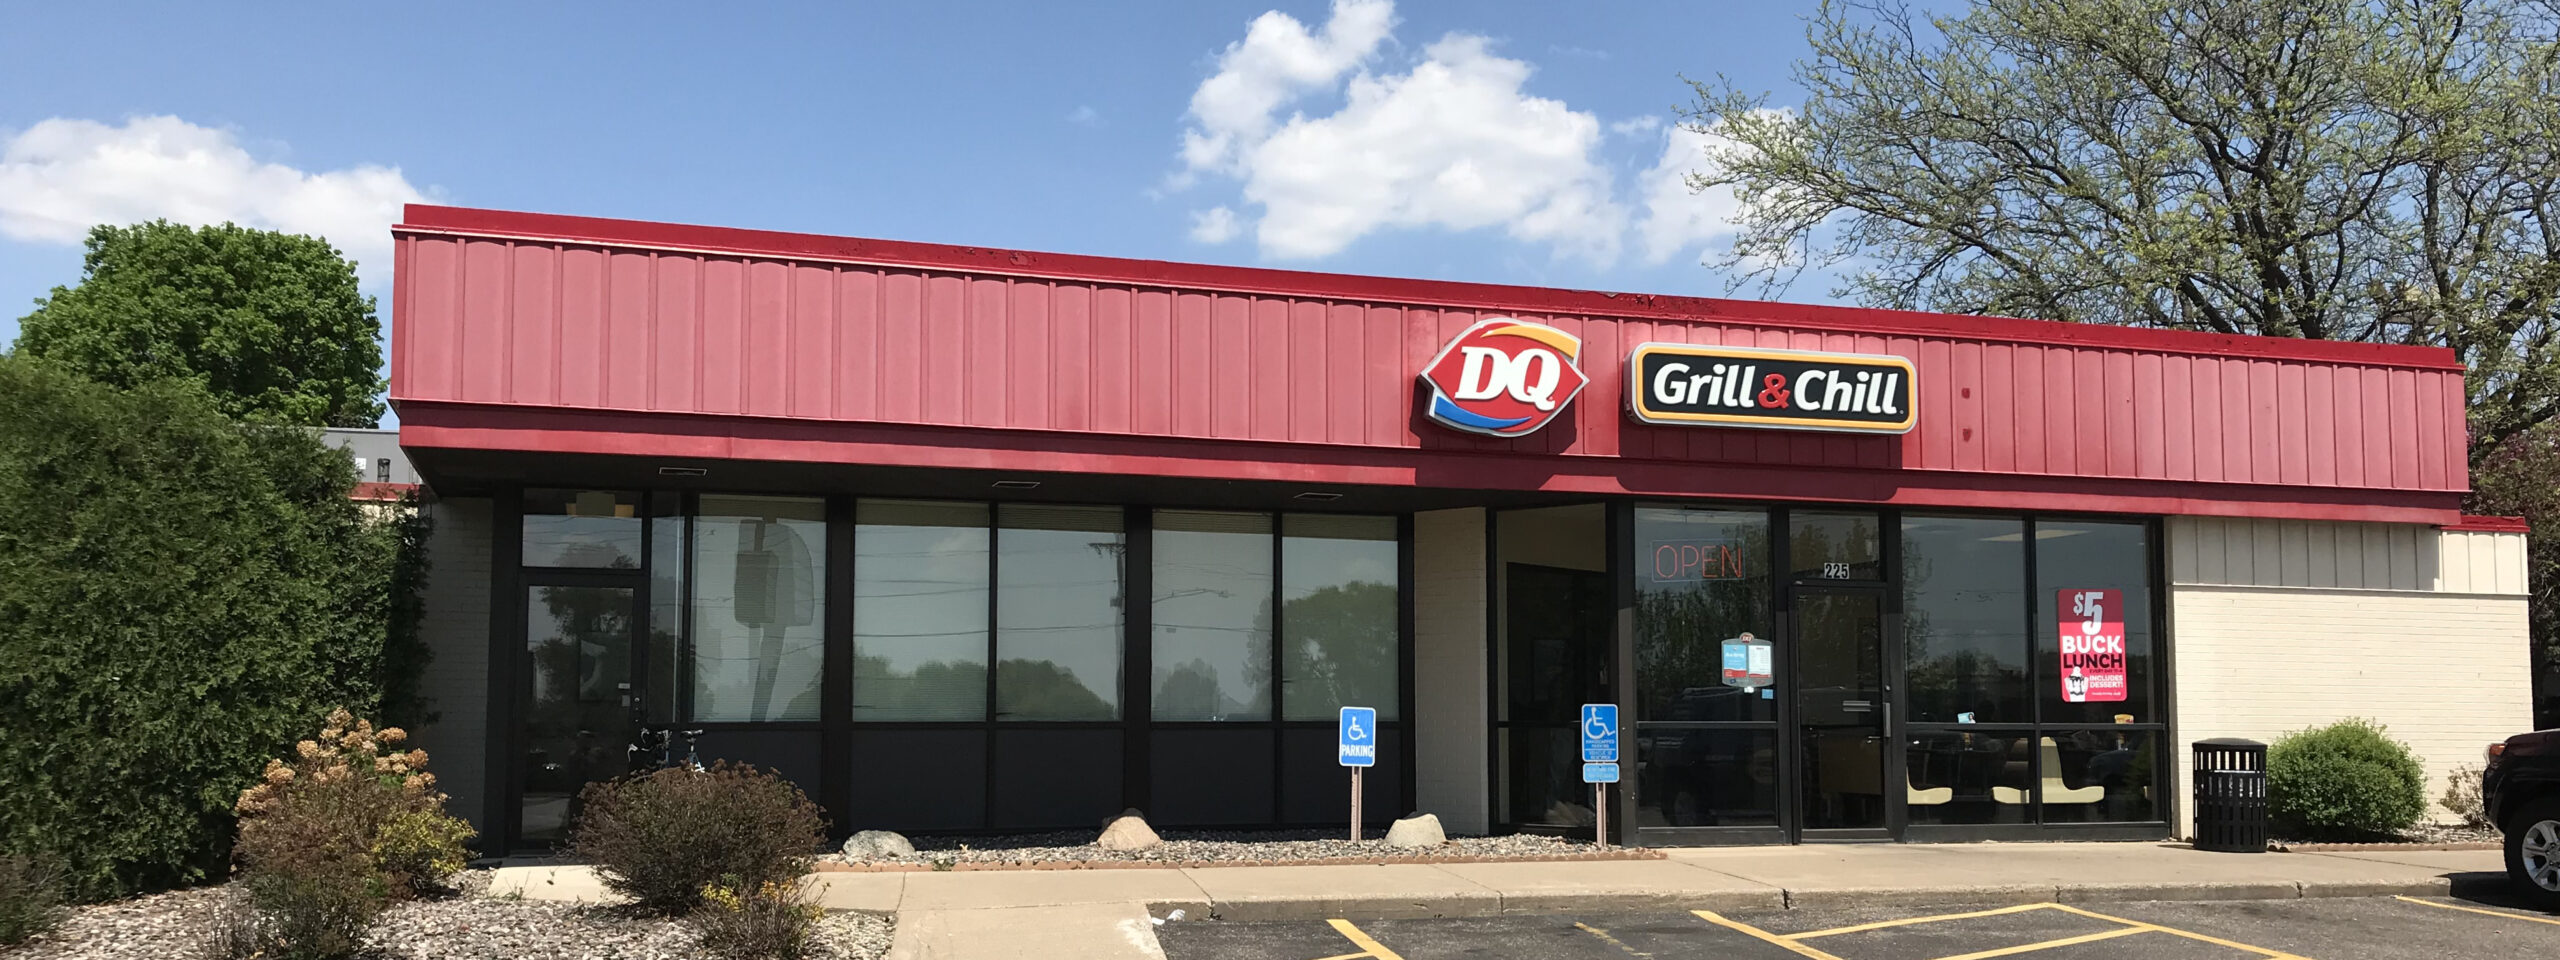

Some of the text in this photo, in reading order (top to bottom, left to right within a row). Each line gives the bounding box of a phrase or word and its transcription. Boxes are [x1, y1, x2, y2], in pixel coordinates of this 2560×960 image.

[1454, 345, 1561, 411] DQ
[1655, 544, 1743, 578] OPEN
[1825, 563, 1848, 579] 225
[2073, 591, 2104, 636] $5
[2062, 635, 2123, 654] BUCK
[2063, 653, 2123, 669] LUNCH
[2089, 674, 2123, 682] INCLUDES
[1341, 743, 1374, 757] PARKING
